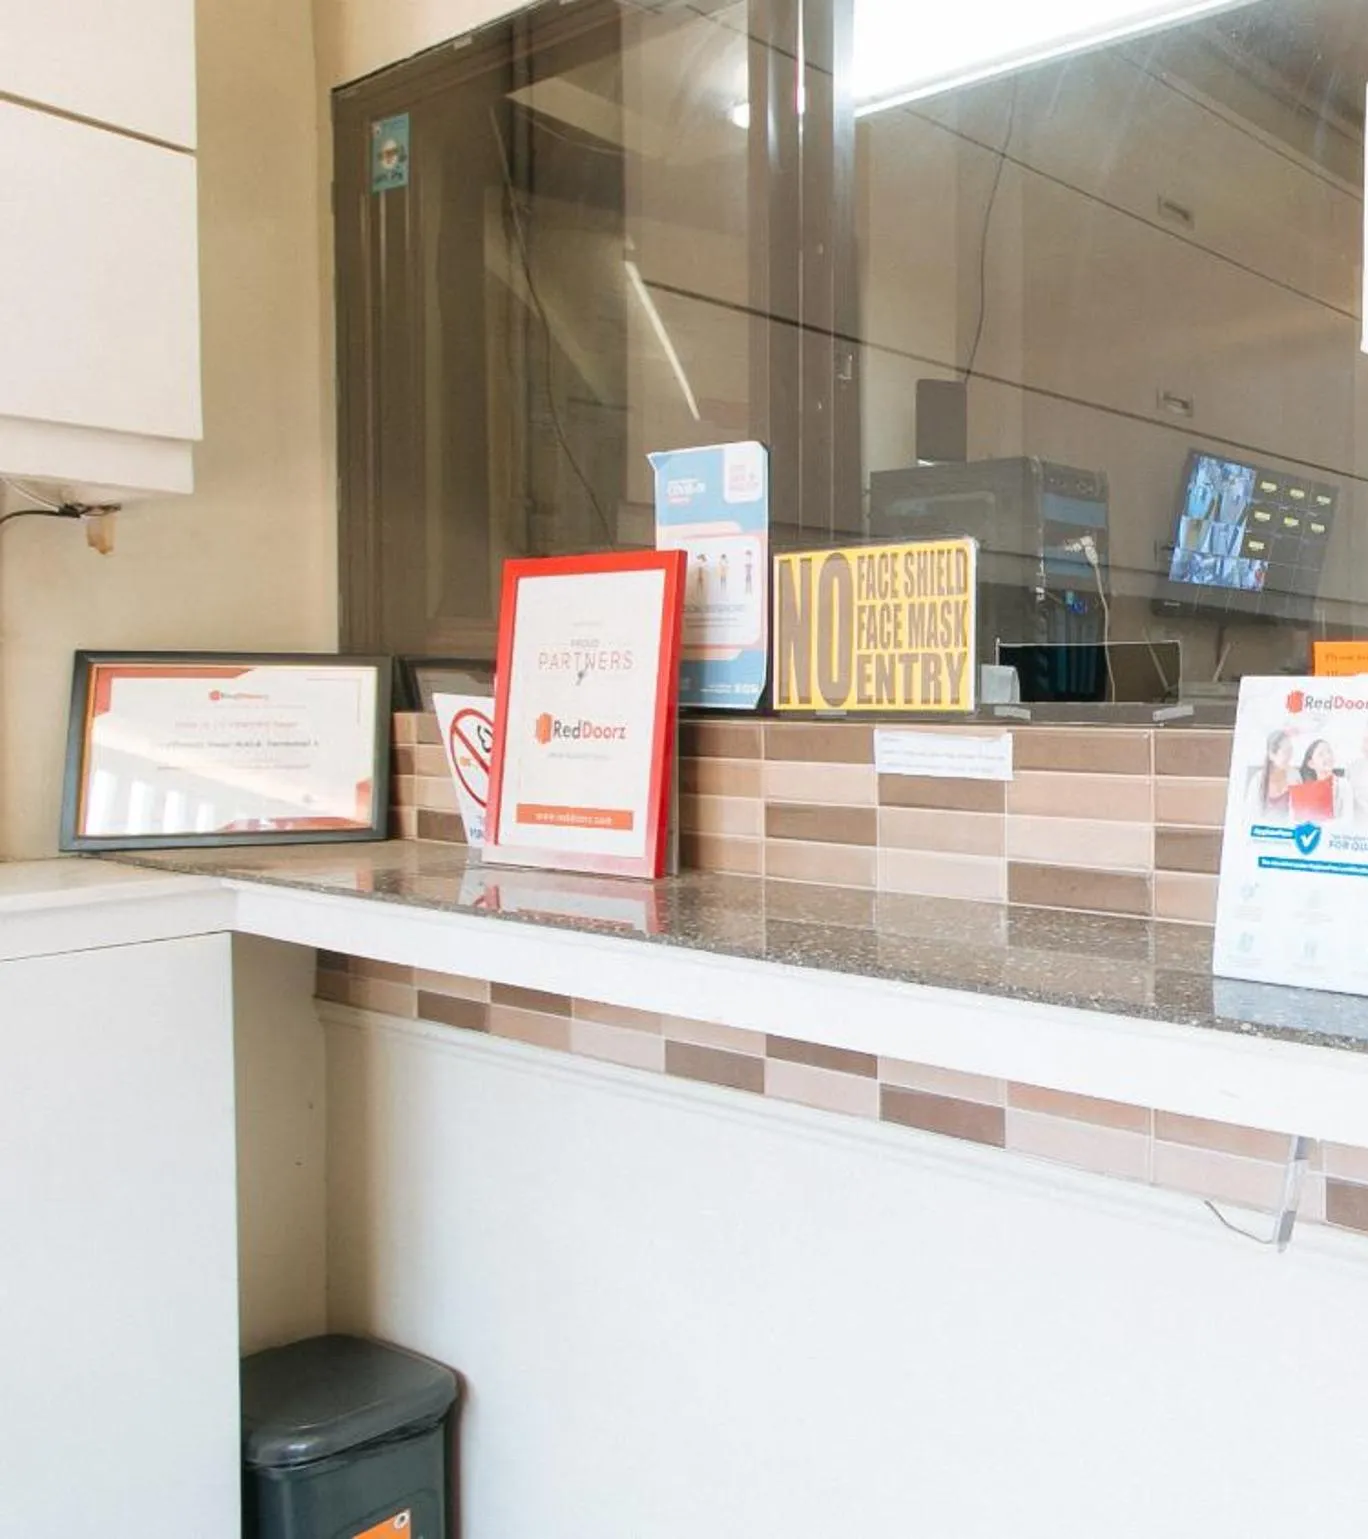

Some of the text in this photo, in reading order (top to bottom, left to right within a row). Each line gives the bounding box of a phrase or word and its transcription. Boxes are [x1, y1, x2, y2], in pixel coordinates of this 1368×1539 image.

[856, 548, 968, 601] FACE SHIELD
[778, 553, 853, 707] NO
[856, 599, 969, 650] FACE MASK
[537, 649, 634, 671] PARTNERS
[856, 651, 968, 705] ENTRY
[553, 719, 627, 740] RedDoorz
[1329, 839, 1350, 850] FOR
